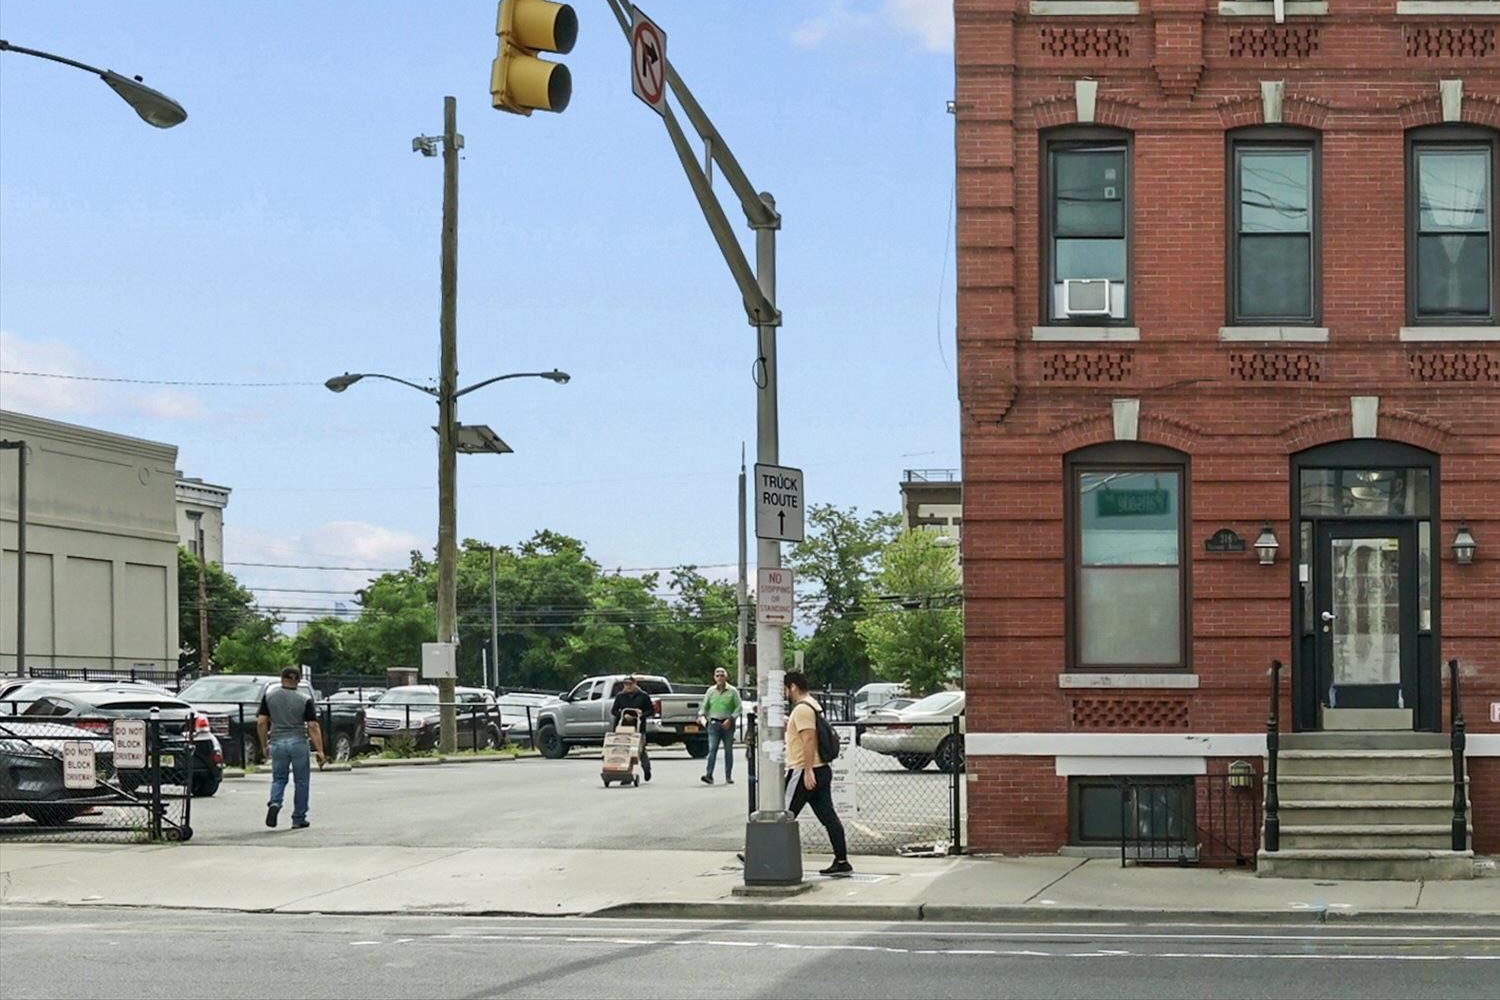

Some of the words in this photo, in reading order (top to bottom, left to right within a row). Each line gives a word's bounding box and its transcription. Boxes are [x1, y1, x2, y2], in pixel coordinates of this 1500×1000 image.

[762, 474, 798, 491] TRUCK
[763, 492, 798, 508] ROUTE
[769, 572, 782, 584] NO
[760, 585, 791, 593] STOPPING
[117, 740, 141, 748] BLOCK
[65, 748, 76, 756] DO
[79, 748, 92, 756] NOT
[115, 752, 143, 760] DRIVEWAY
[68, 761, 91, 769] BLOCK
